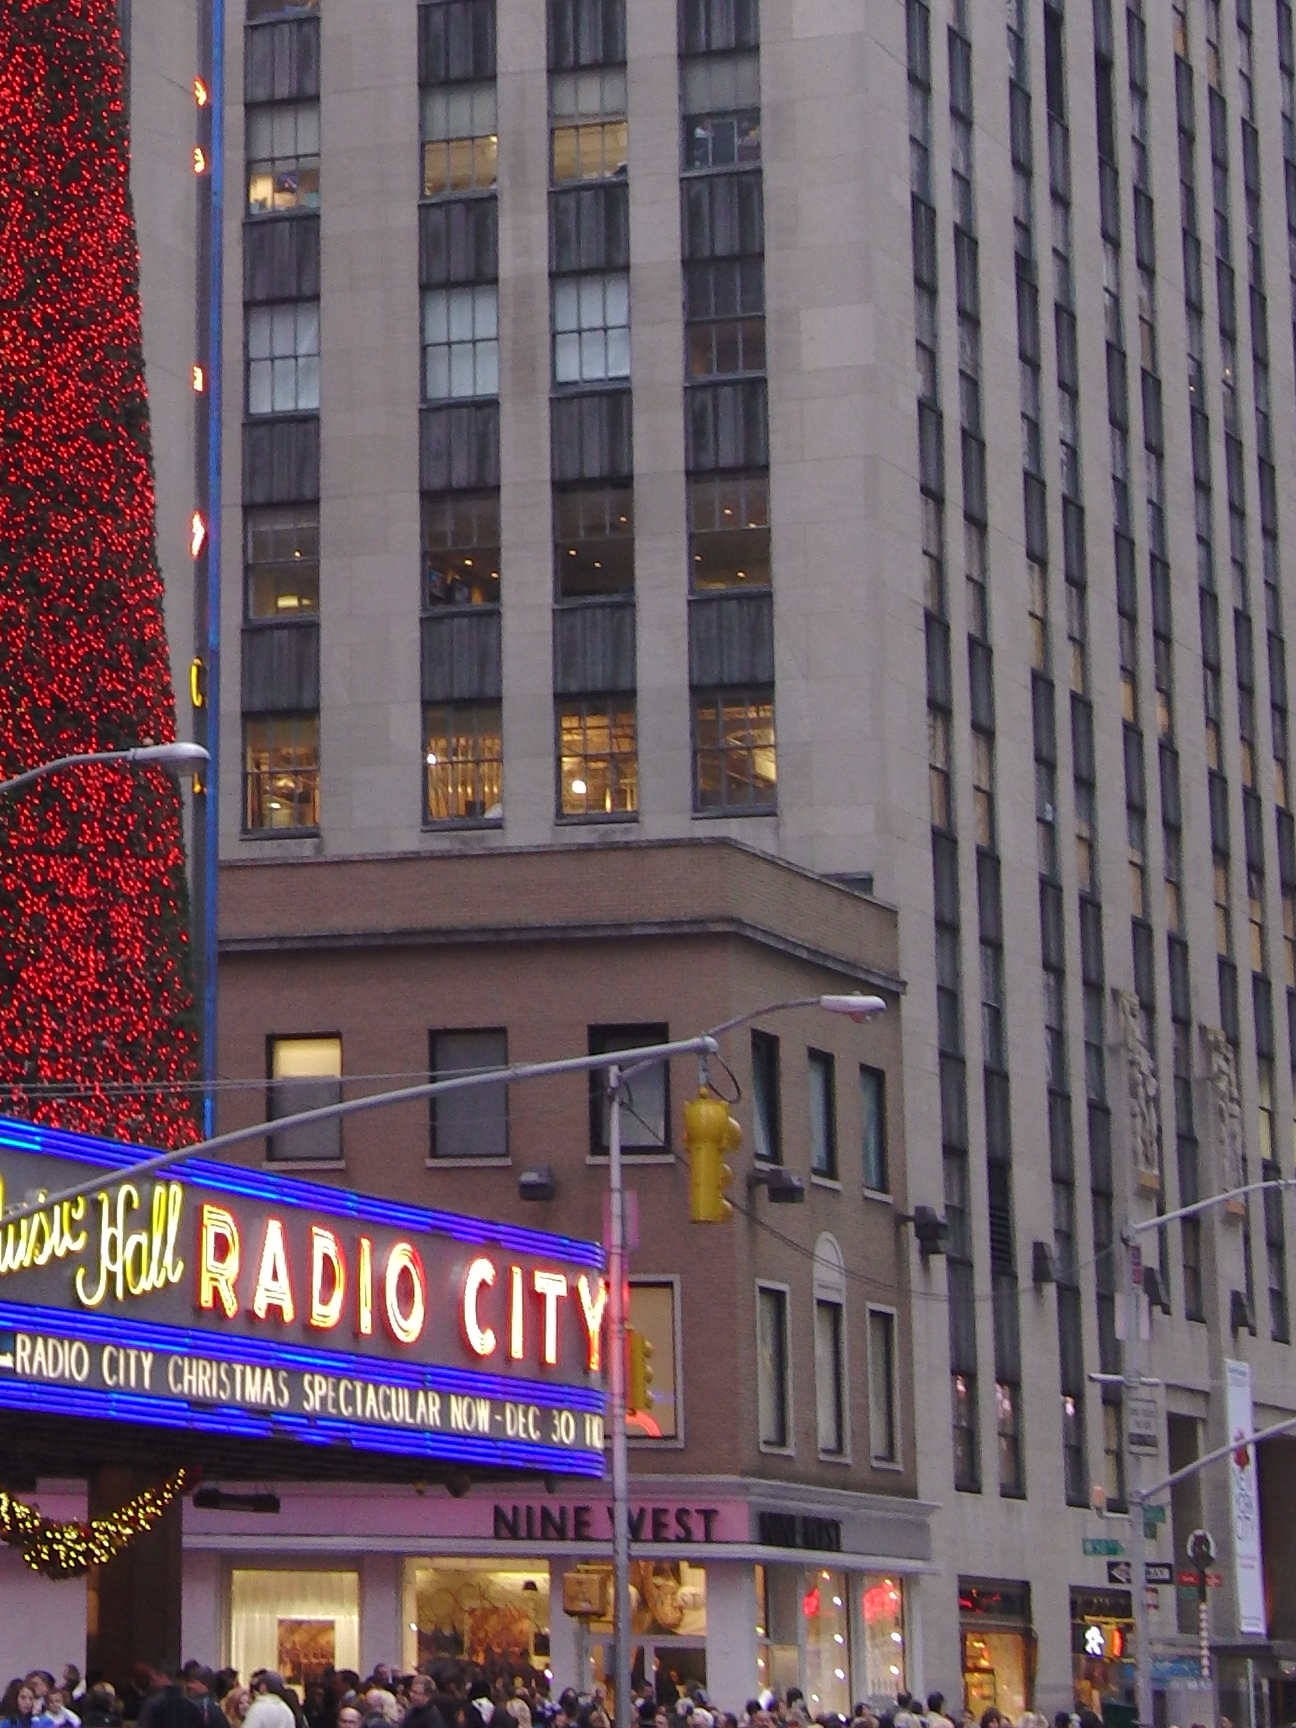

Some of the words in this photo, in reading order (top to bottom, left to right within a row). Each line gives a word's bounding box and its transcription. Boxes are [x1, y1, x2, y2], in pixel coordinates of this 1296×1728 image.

[75, 1181, 184, 1307] Hall
[199, 1203, 426, 1345] RADIO
[461, 1256, 608, 1372] CITY
[15, 1332, 90, 1383] RADIO
[102, 1344, 154, 1391] CITY
[167, 1354, 290, 1409] CHRISTMAS
[302, 1372, 442, 1428] SPECTACULAR
[551, 1408, 575, 1446] 30
[493, 1504, 592, 1541] NINE
[606, 1505, 719, 1543] WEST
